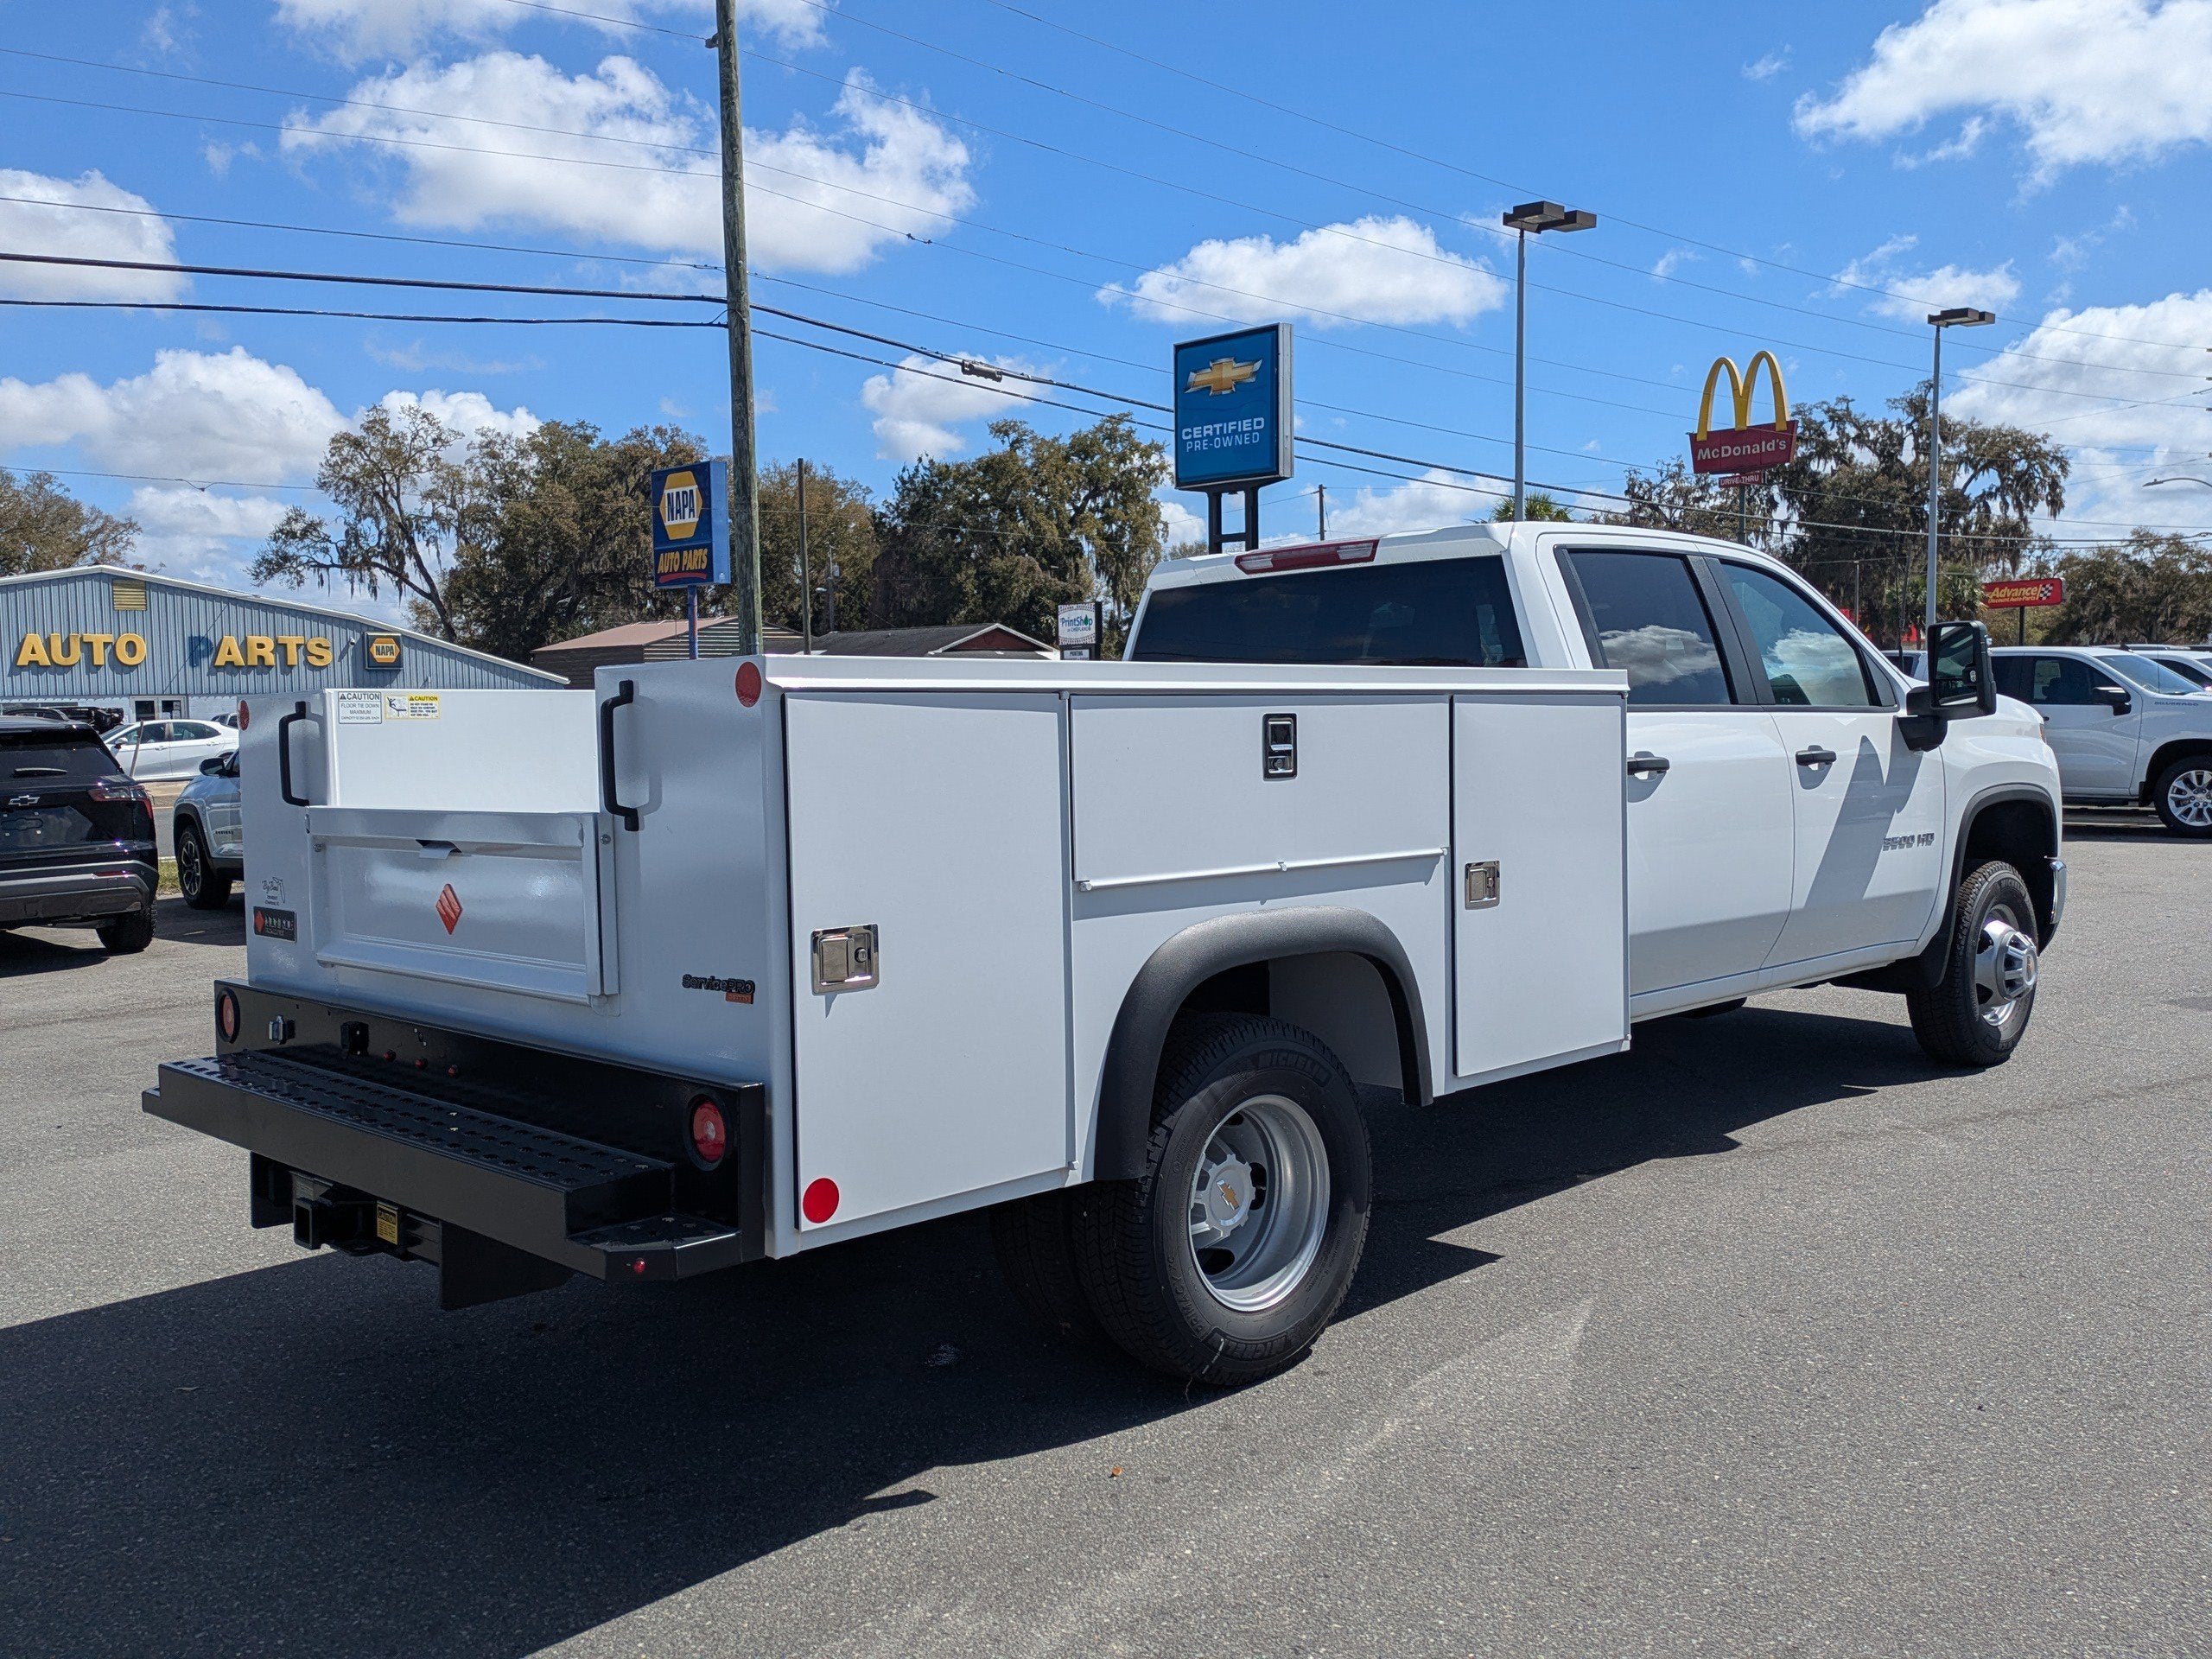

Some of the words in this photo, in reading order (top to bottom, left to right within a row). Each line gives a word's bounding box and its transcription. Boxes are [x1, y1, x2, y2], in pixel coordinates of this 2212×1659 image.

[1181, 416, 1265, 441] CERTIFIED
[1186, 432, 1260, 453] PRE-OWNED
[1697, 438, 1787, 461] McDonald's
[666, 489, 696, 522] NAPA
[658, 550, 680, 573] AUTO
[682, 548, 708, 570] PARTS
[1988, 587, 2038, 599] Advance
[16, 632, 147, 666] AUTO
[188, 634, 334, 668] PARTS
[375, 645, 395, 656] NAPA
[682, 974, 755, 994] ServicePRO
